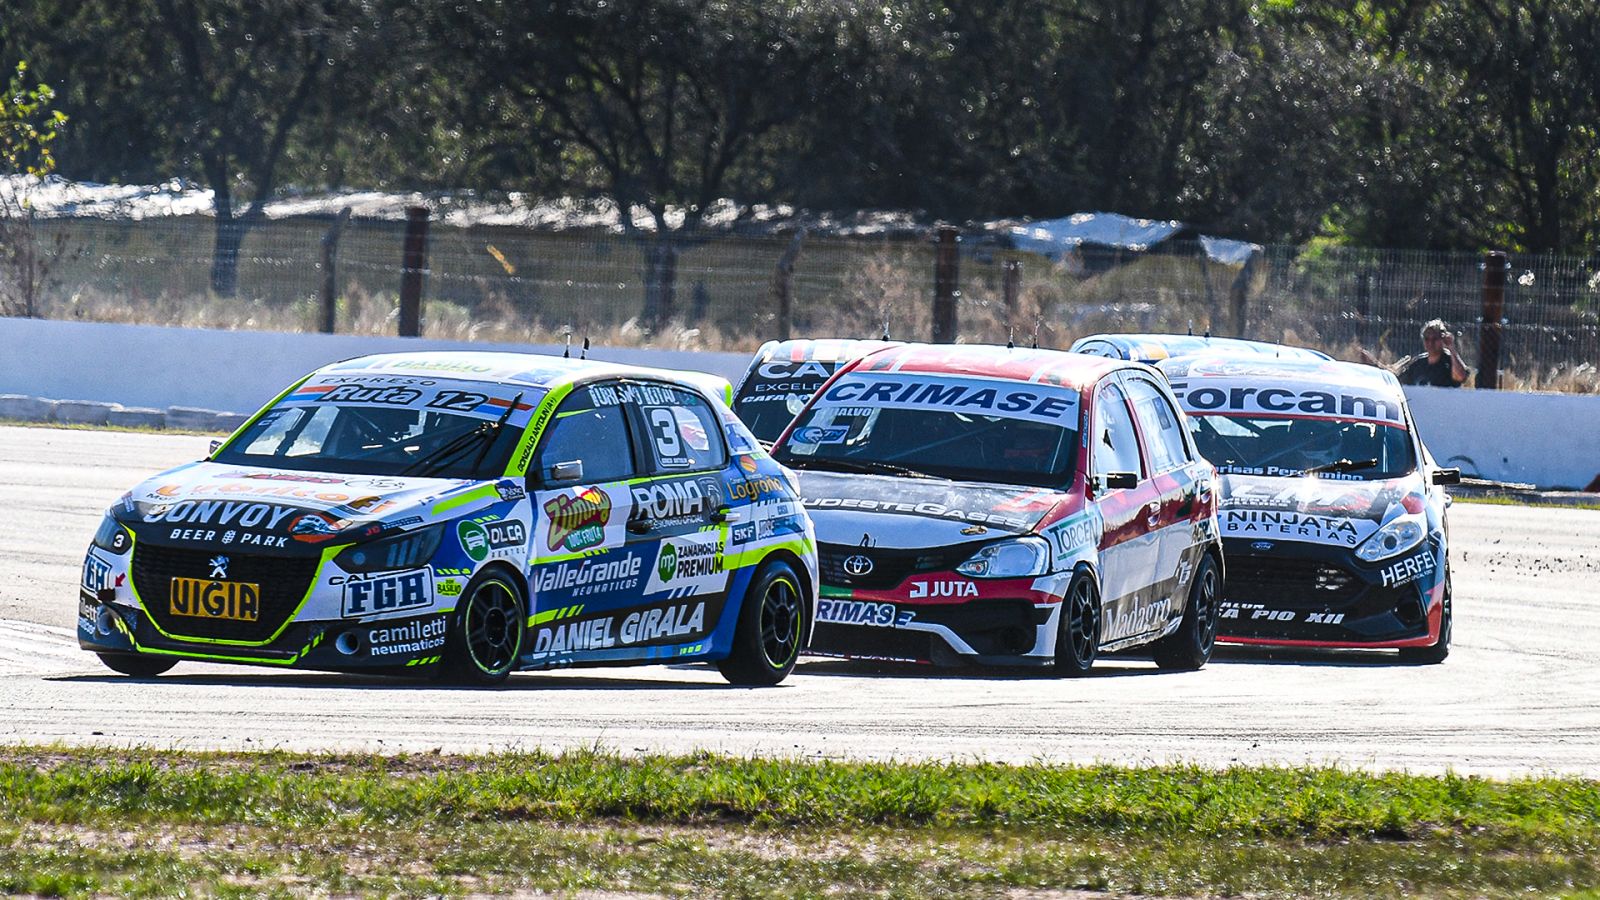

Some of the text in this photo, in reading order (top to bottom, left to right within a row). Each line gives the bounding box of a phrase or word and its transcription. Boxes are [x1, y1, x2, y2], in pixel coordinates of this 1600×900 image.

[320, 377, 437, 387] EXPRESO
[314, 384, 490, 412] Ruta 12
[641, 386, 680, 405] TOTAL
[825, 382, 1076, 419] CRIMASE
[651, 408, 681, 457] 3
[632, 481, 703, 519] ROMA
[734, 527, 755, 543] SKF
[1227, 511, 1358, 536] NINJATA
[1227, 523, 1357, 546] BATERIAS
[113, 534, 124, 548] 3
[169, 528, 289, 548] BEER PARK
[678, 542, 724, 559] ZANAHORIAS
[534, 552, 642, 593] ValleGrande
[677, 556, 724, 579] PREMIUM
[347, 572, 427, 614] FGH
[572, 578, 638, 597] NEUMATICOS
[930, 581, 979, 598] JUTA
[817, 600, 914, 627] RIMASE
[1251, 610, 1296, 621] PIO
[1304, 612, 1345, 625] XII
[369, 615, 446, 644] camiletti
[533, 602, 705, 660] DANIEL GIRALA
[371, 636, 445, 656] neumaticos
